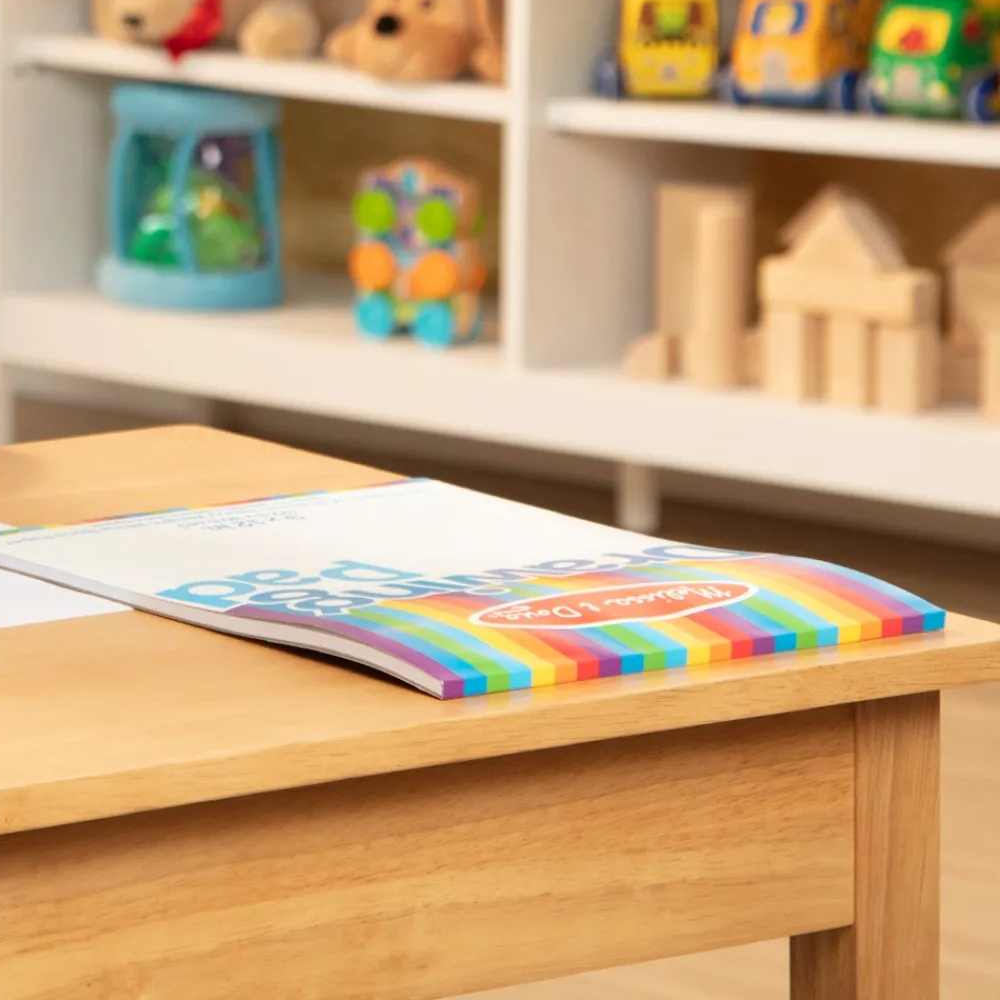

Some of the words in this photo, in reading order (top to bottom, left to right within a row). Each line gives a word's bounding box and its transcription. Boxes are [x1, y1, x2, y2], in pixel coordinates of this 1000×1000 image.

[154, 560, 424, 609] Pad
[249, 545, 755, 614] Drawing
[603, 584, 733, 605] Melissa
[494, 604, 582, 621] Doug
[579, 600, 601, 613] &
